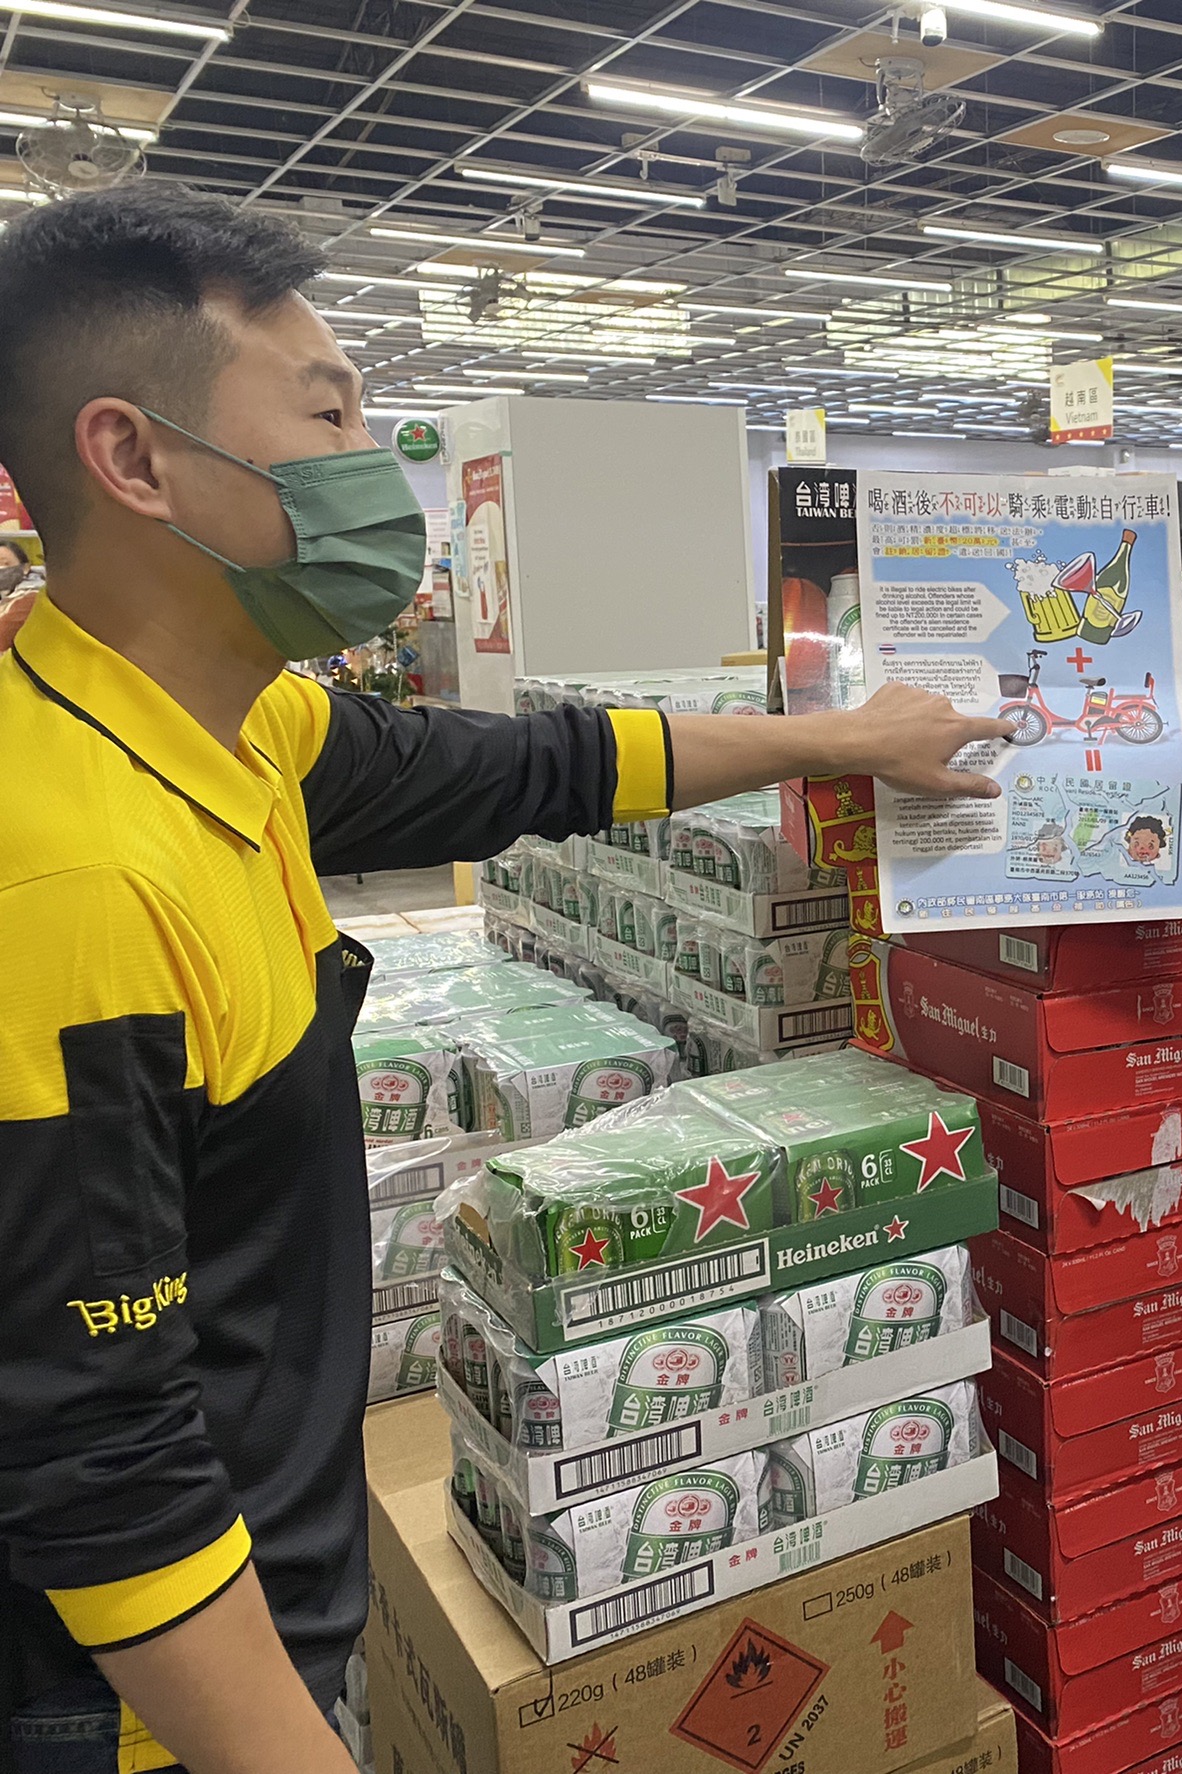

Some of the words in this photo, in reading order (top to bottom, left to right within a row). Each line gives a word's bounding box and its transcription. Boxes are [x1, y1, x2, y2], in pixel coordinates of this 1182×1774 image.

[1066, 412, 1098, 424] Vietnam
[796, 507, 836, 518] TAIWAN
[1135, 925, 1160, 940] San
[919, 996, 941, 1024] San
[941, 1004, 980, 1043] Miguel
[1126, 1051, 1152, 1068] San
[379, 1060, 409, 1070] FLAVOR
[412, 1066, 427, 1083] LAGER
[374, 1092, 400, 1102] 金牌
[424, 1124, 433, 1138] 6
[861, 1154, 877, 1178] 6
[884, 1159, 892, 1167] 33
[860, 1178, 880, 1189] PACK
[631, 1204, 649, 1229] 6
[656, 1207, 666, 1216] 33
[630, 1227, 651, 1240] PACK
[777, 1230, 878, 1270] Heineken
[855, 1271, 886, 1314] DISTINCTIVE
[890, 1268, 924, 1276] FLAVOR
[927, 1272, 942, 1290] LAGER
[598, 1285, 735, 1328] 18712000018754
[885, 1307, 914, 1318] 金牌
[1133, 1301, 1158, 1318] San
[621, 1335, 657, 1381] DISTINCTIVE
[662, 1332, 701, 1340] FLAVOR
[705, 1337, 724, 1355] LAGER
[656, 1374, 690, 1385] 金牌
[719, 1408, 748, 1426] 金牌
[864, 1408, 894, 1452] DISTINCTIVE
[898, 1404, 931, 1412] FLAVOR
[934, 1408, 949, 1425] LAGER
[1129, 1423, 1154, 1440] San
[894, 1443, 922, 1455] 金牌
[634, 1481, 670, 1530] DISTINCTIVE
[674, 1478, 712, 1486] FLAVOR
[715, 1482, 733, 1500] LAGER
[669, 1519, 702, 1532] 金牌
[1134, 1538, 1158, 1556] San
[729, 1548, 757, 1568] 金牌
[835, 1582, 875, 1608] 250g
[1131, 1651, 1157, 1670] San
[558, 1684, 604, 1712] 220g
[883, 1657, 909, 1752] 小心搬運
[747, 1724, 761, 1747] 2
[779, 1733, 806, 1762] UN
[801, 1695, 830, 1731] 2037
